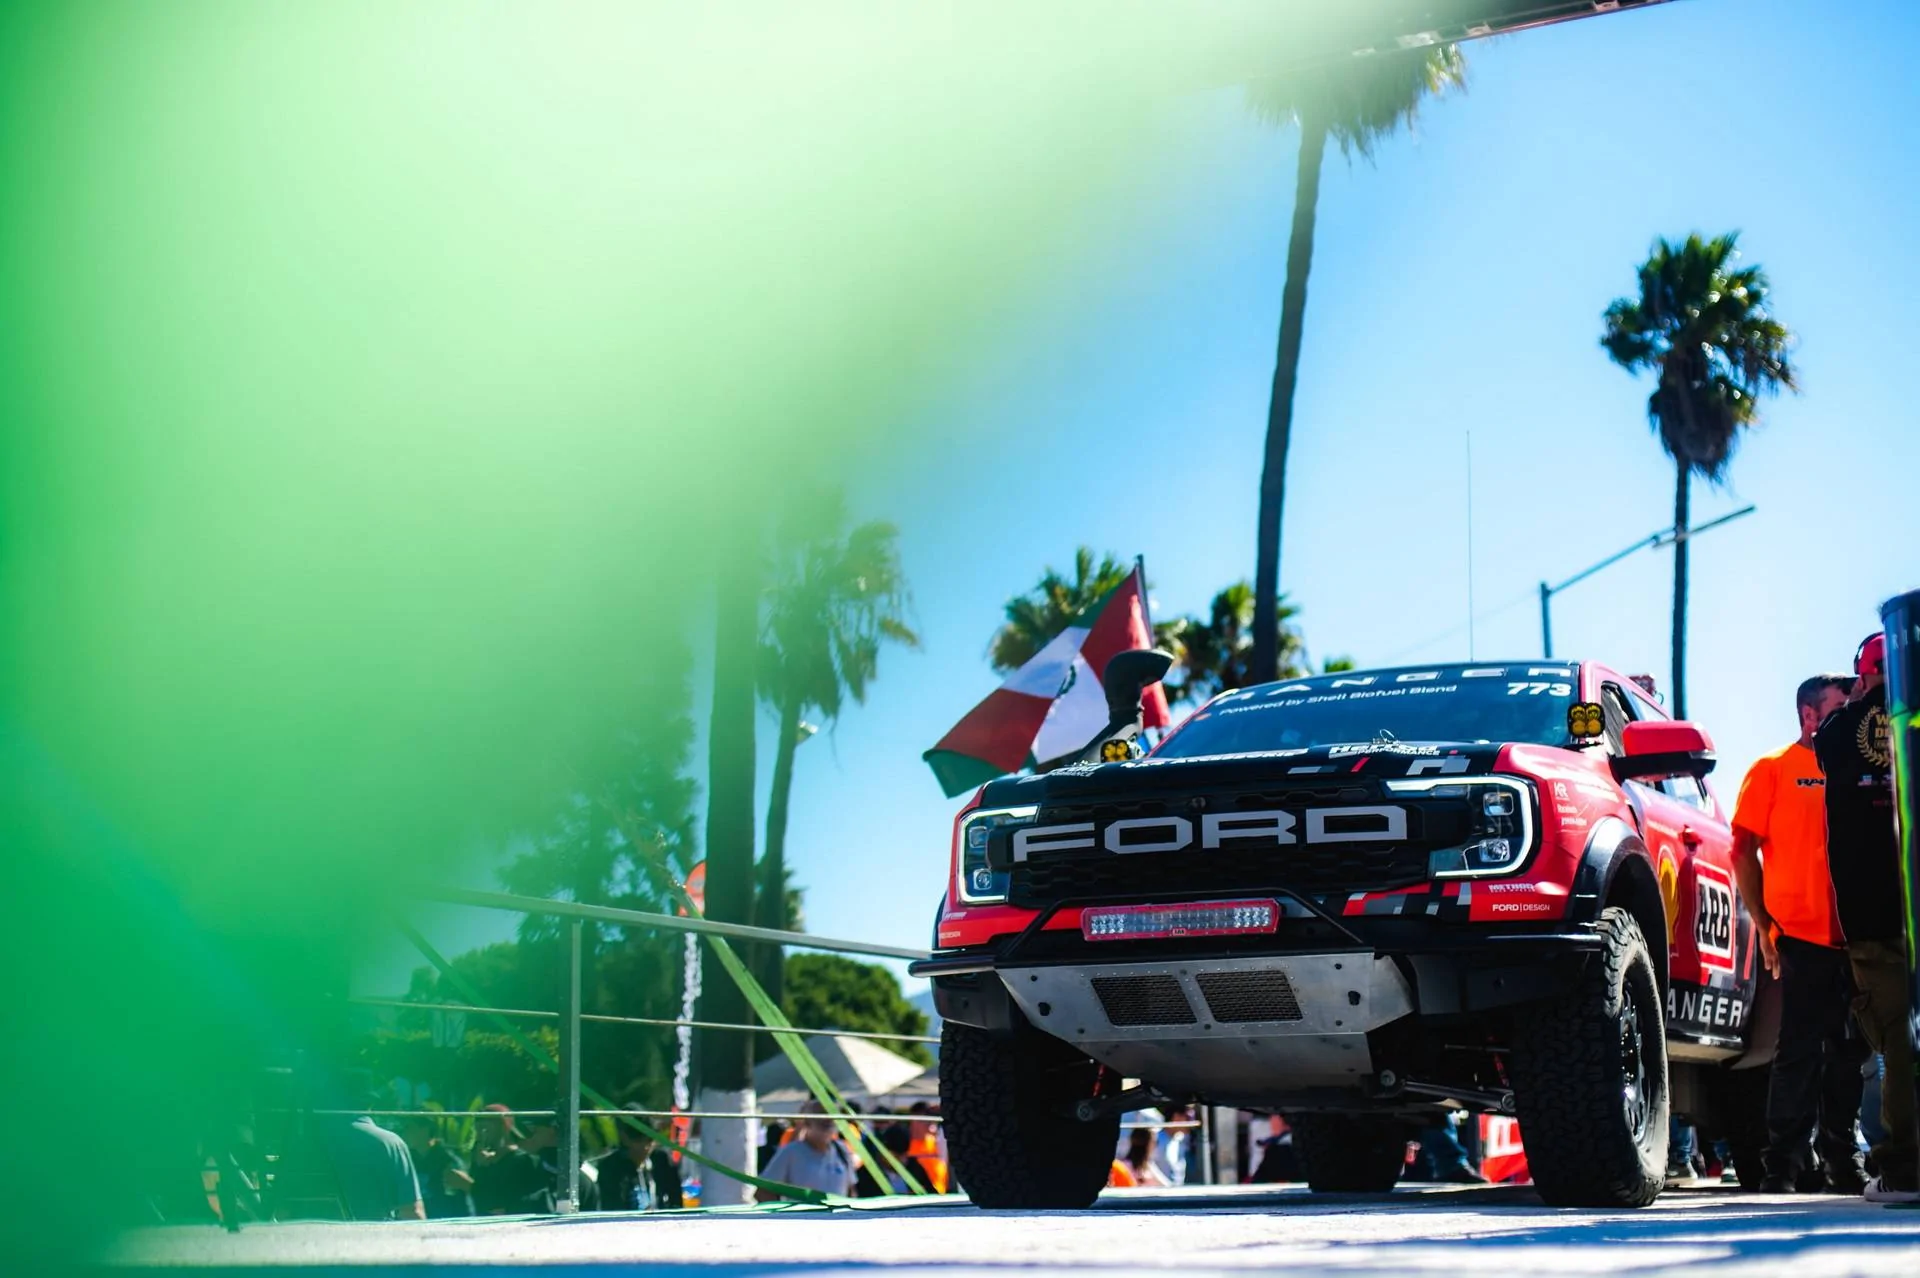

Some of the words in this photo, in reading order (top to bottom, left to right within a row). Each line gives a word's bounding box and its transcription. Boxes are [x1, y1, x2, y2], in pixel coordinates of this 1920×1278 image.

[1219, 702, 1283, 716] Powered
[1286, 698, 1305, 706] by
[1307, 692, 1347, 704] Shell
[1350, 687, 1406, 699] Biofuel
[1409, 684, 1458, 695] Blend
[1507, 682, 1572, 697] 773
[1012, 804, 1408, 863] FORD
[1492, 903, 1519, 912] FORD
[1522, 903, 1551, 912] DESIGN
[1697, 882, 1731, 951] ARB
[1666, 988, 1743, 1028] ANGER
